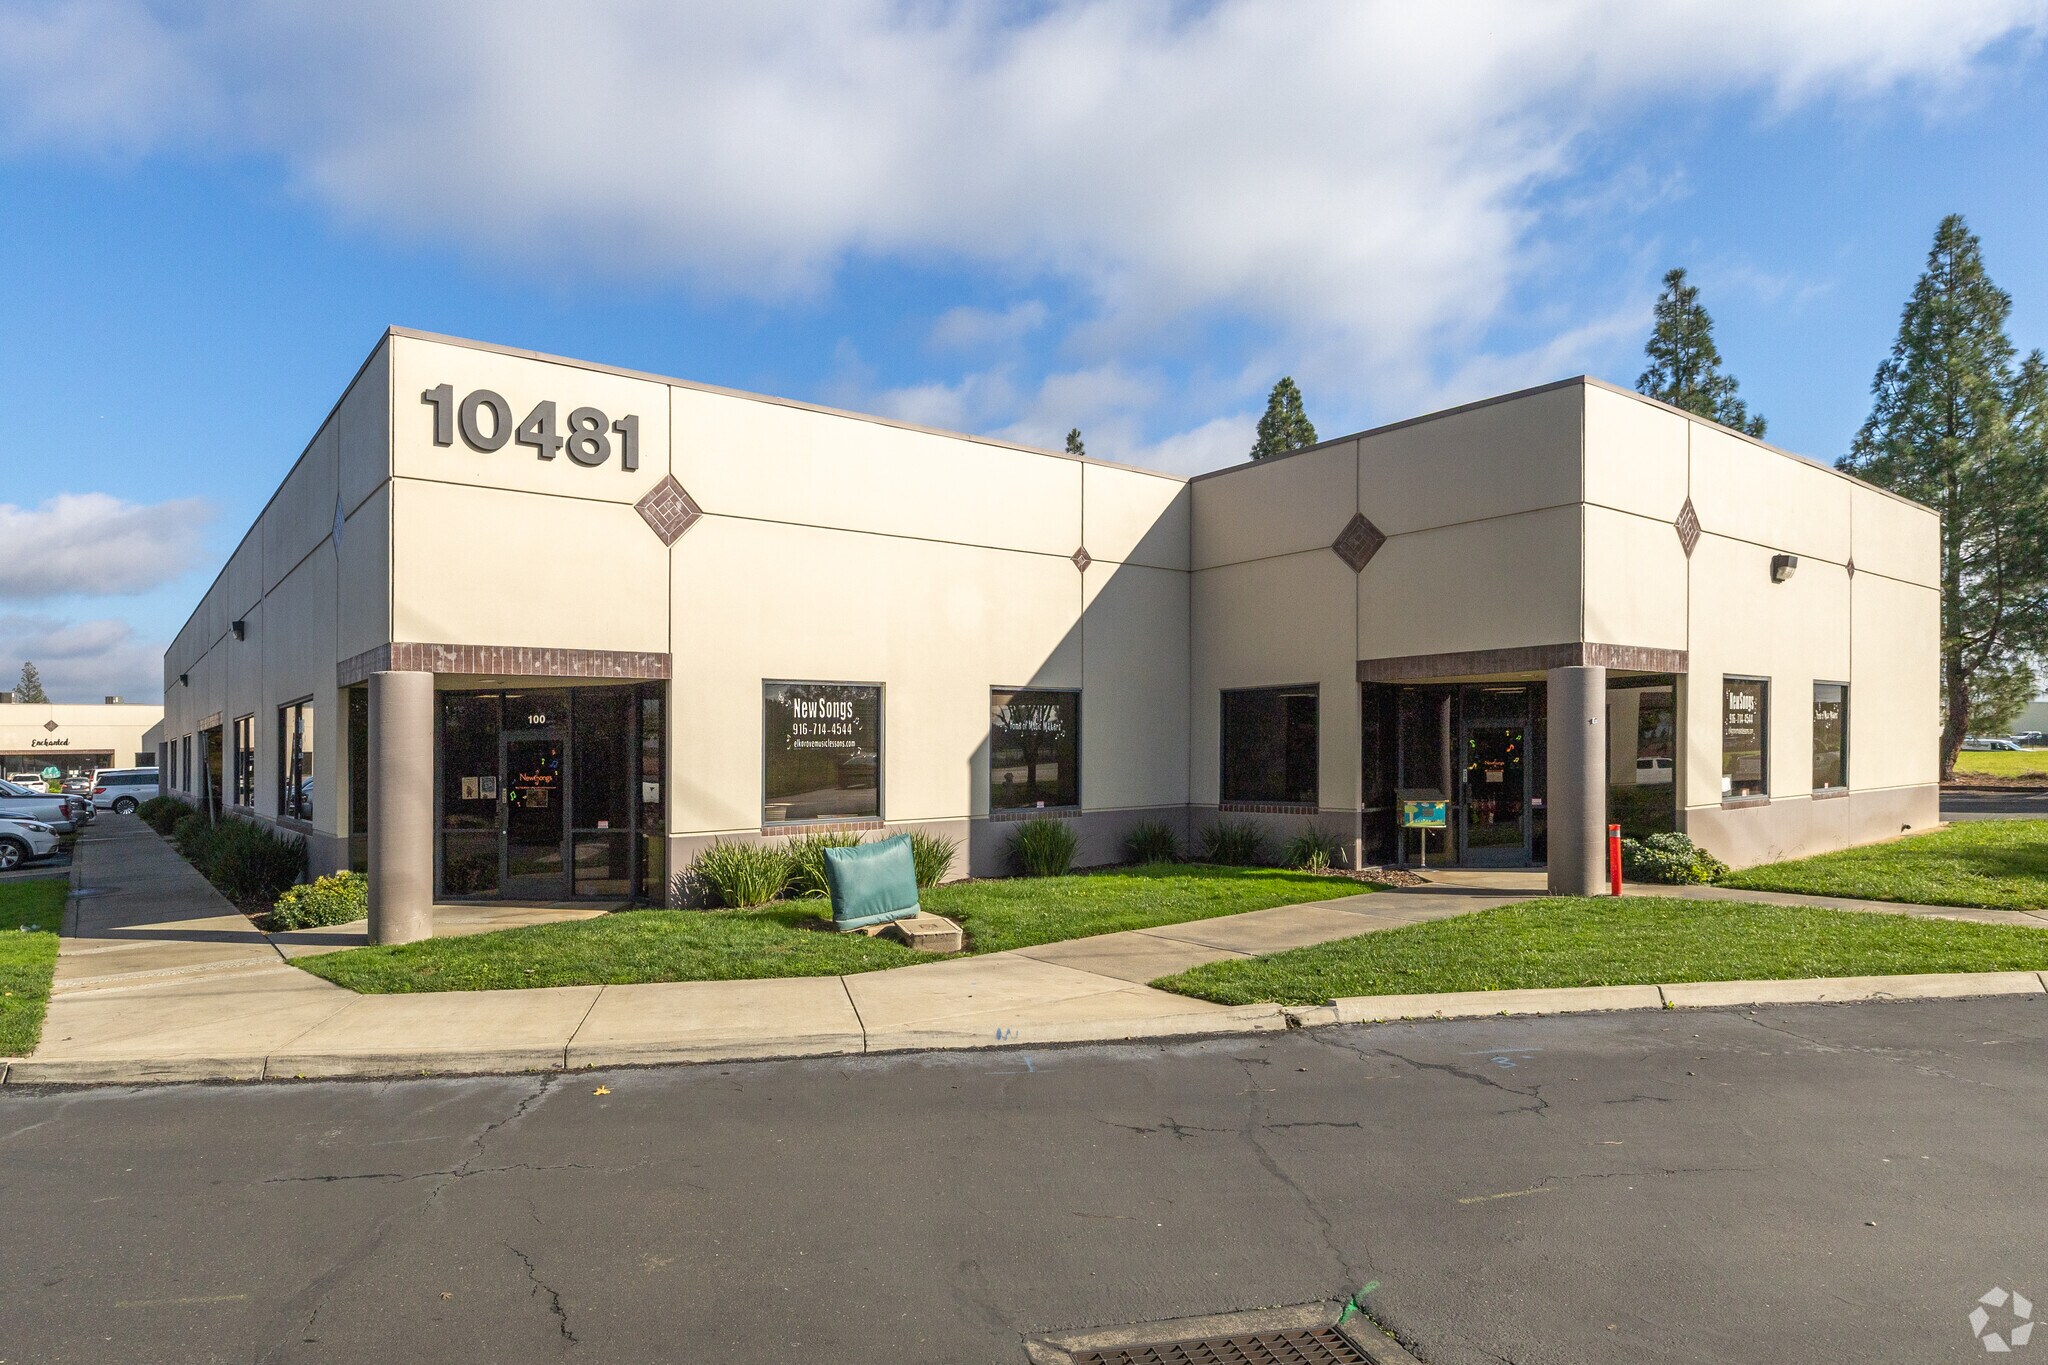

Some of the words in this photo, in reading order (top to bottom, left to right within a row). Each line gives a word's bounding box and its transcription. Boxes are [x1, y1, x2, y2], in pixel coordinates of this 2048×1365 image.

[422, 383, 639, 472] 10481
[528, 715, 546, 724] 100
[792, 723, 852, 735] 916-714-4544
[31, 738, 70, 747] Enchanted
